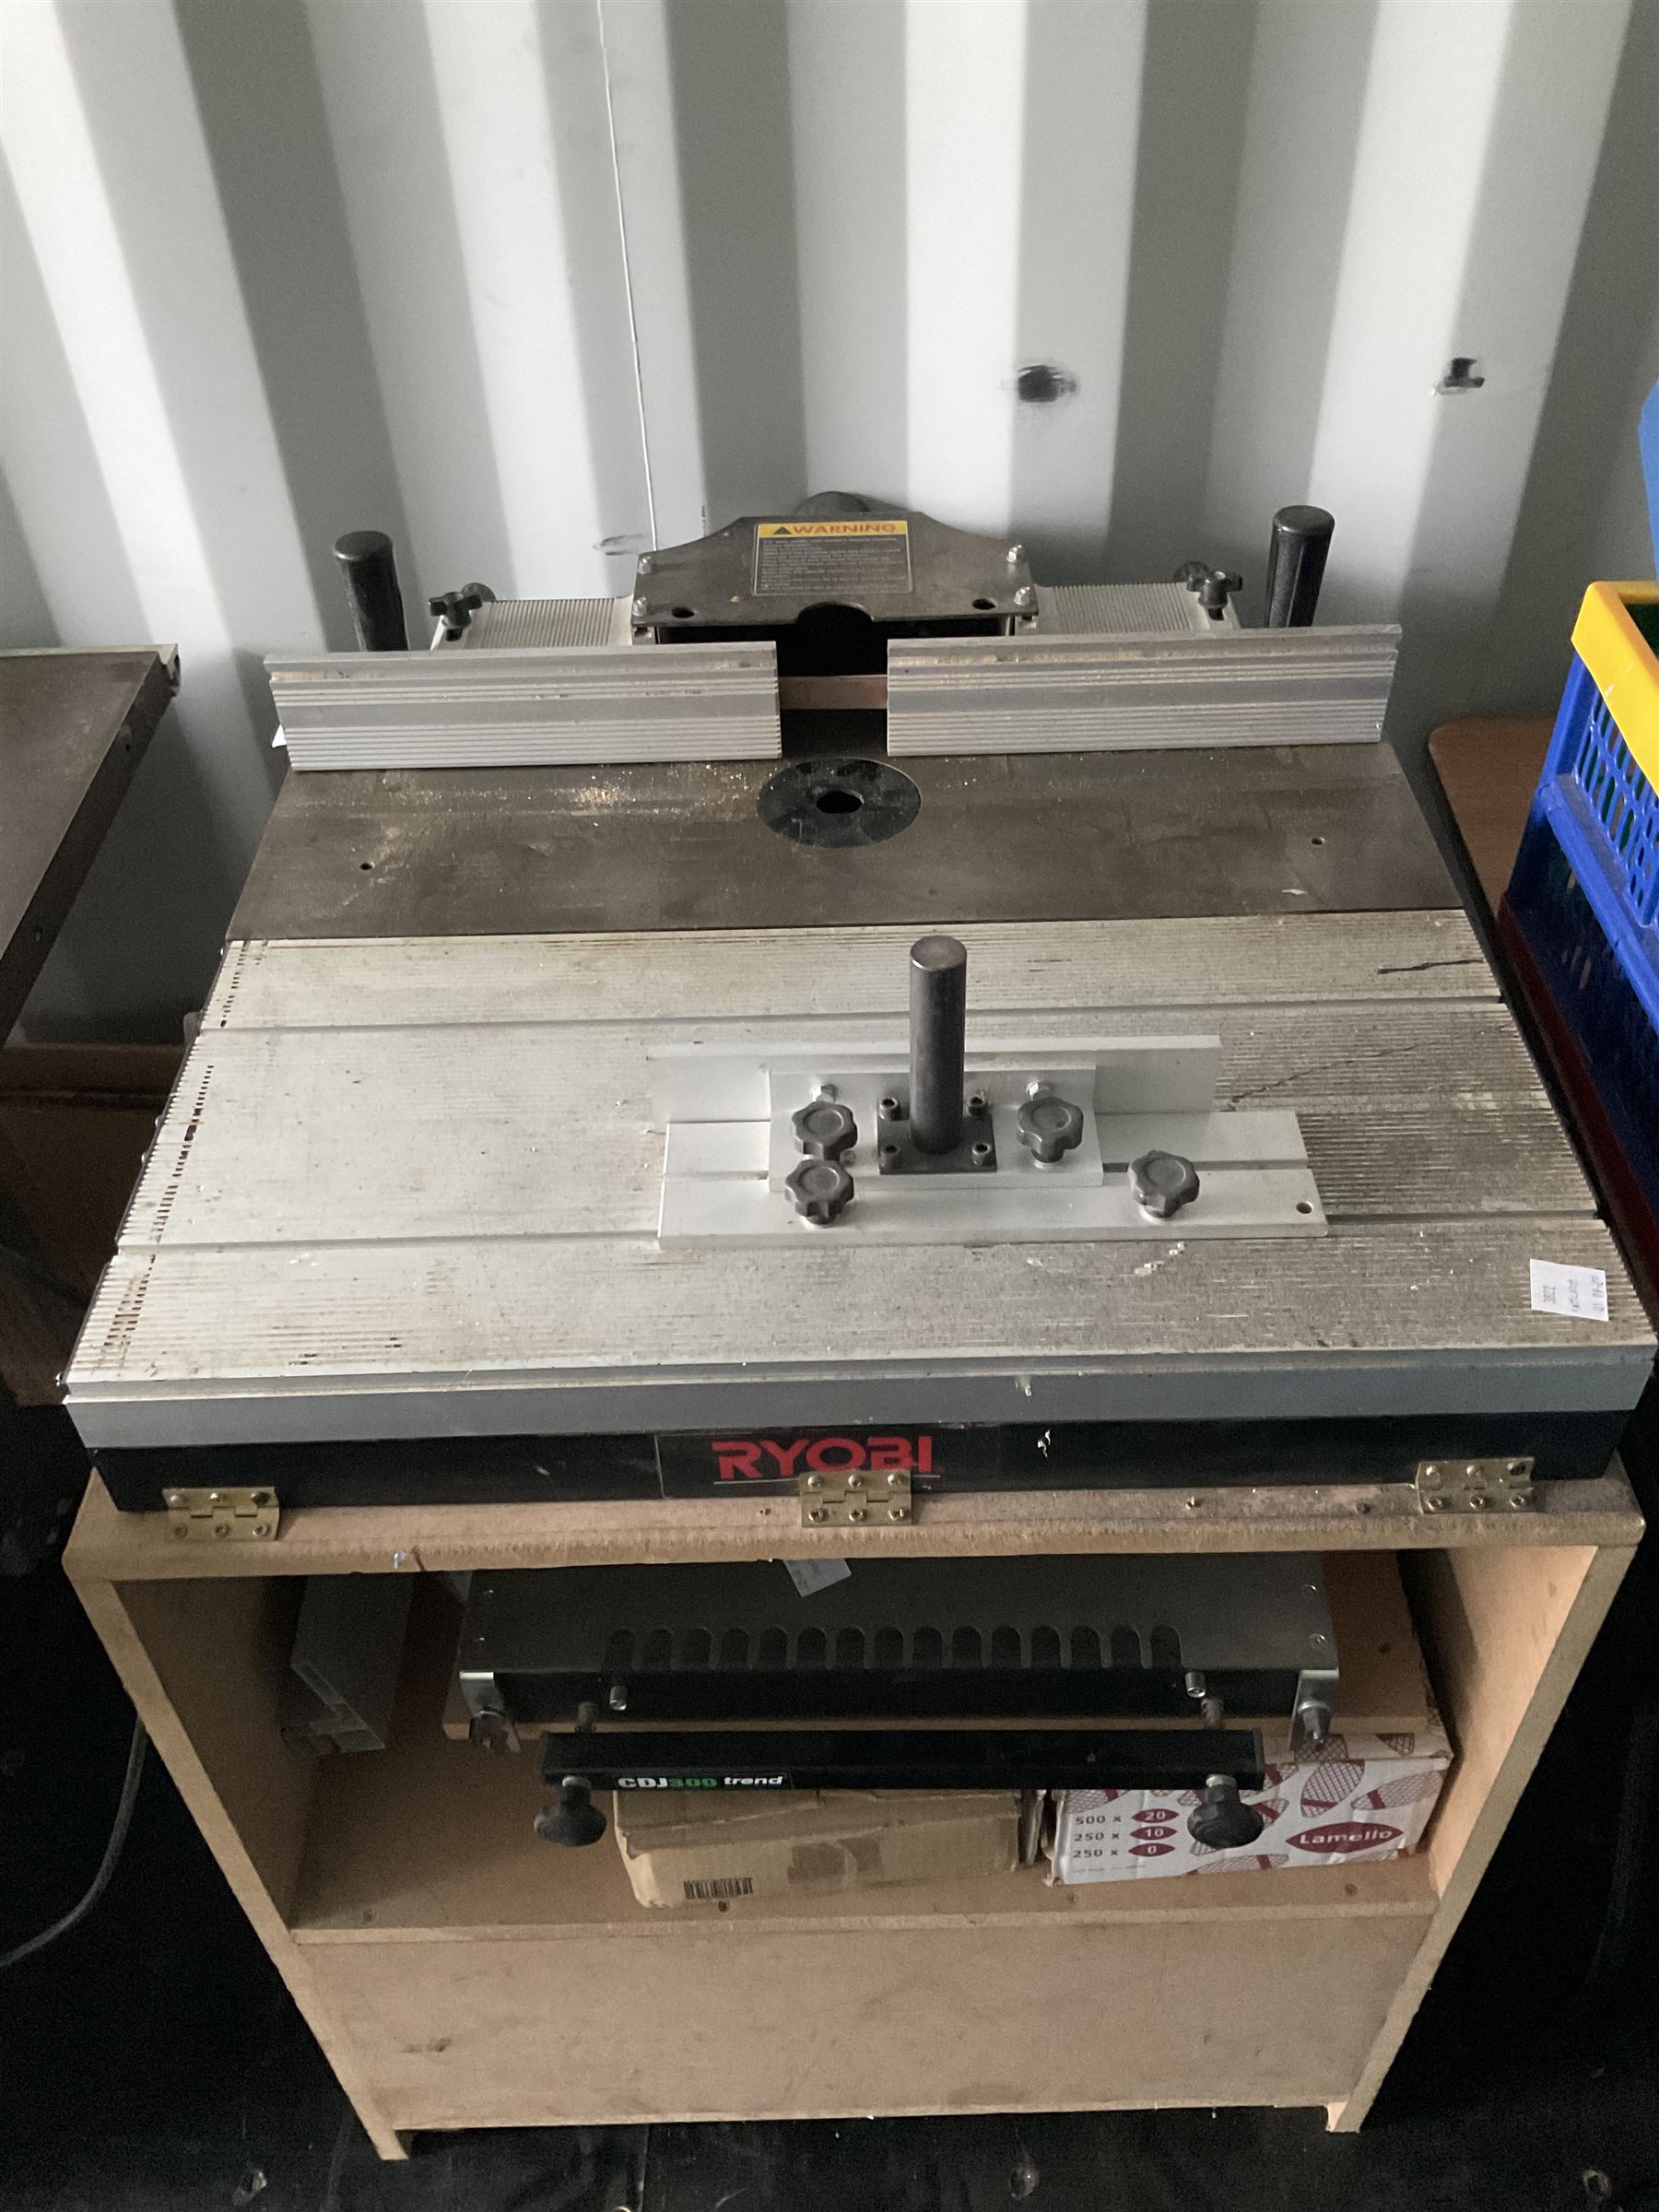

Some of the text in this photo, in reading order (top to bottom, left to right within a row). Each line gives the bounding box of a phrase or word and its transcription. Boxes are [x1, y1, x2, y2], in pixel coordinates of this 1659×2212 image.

[794, 524, 897, 535] WARNING
[712, 1435, 933, 1479] RYOBI
[618, 1776, 783, 1788] CDJ300 trend
[1076, 1816, 1106, 1825] 500
[1145, 1811, 1166, 1821] 20
[1074, 1832, 1105, 1842] 250
[1145, 1829, 1164, 1838] 10
[1300, 1830, 1393, 1844] Lamello
[1073, 1849, 1103, 1859] 250
[1147, 1845, 1157, 1854] 0
